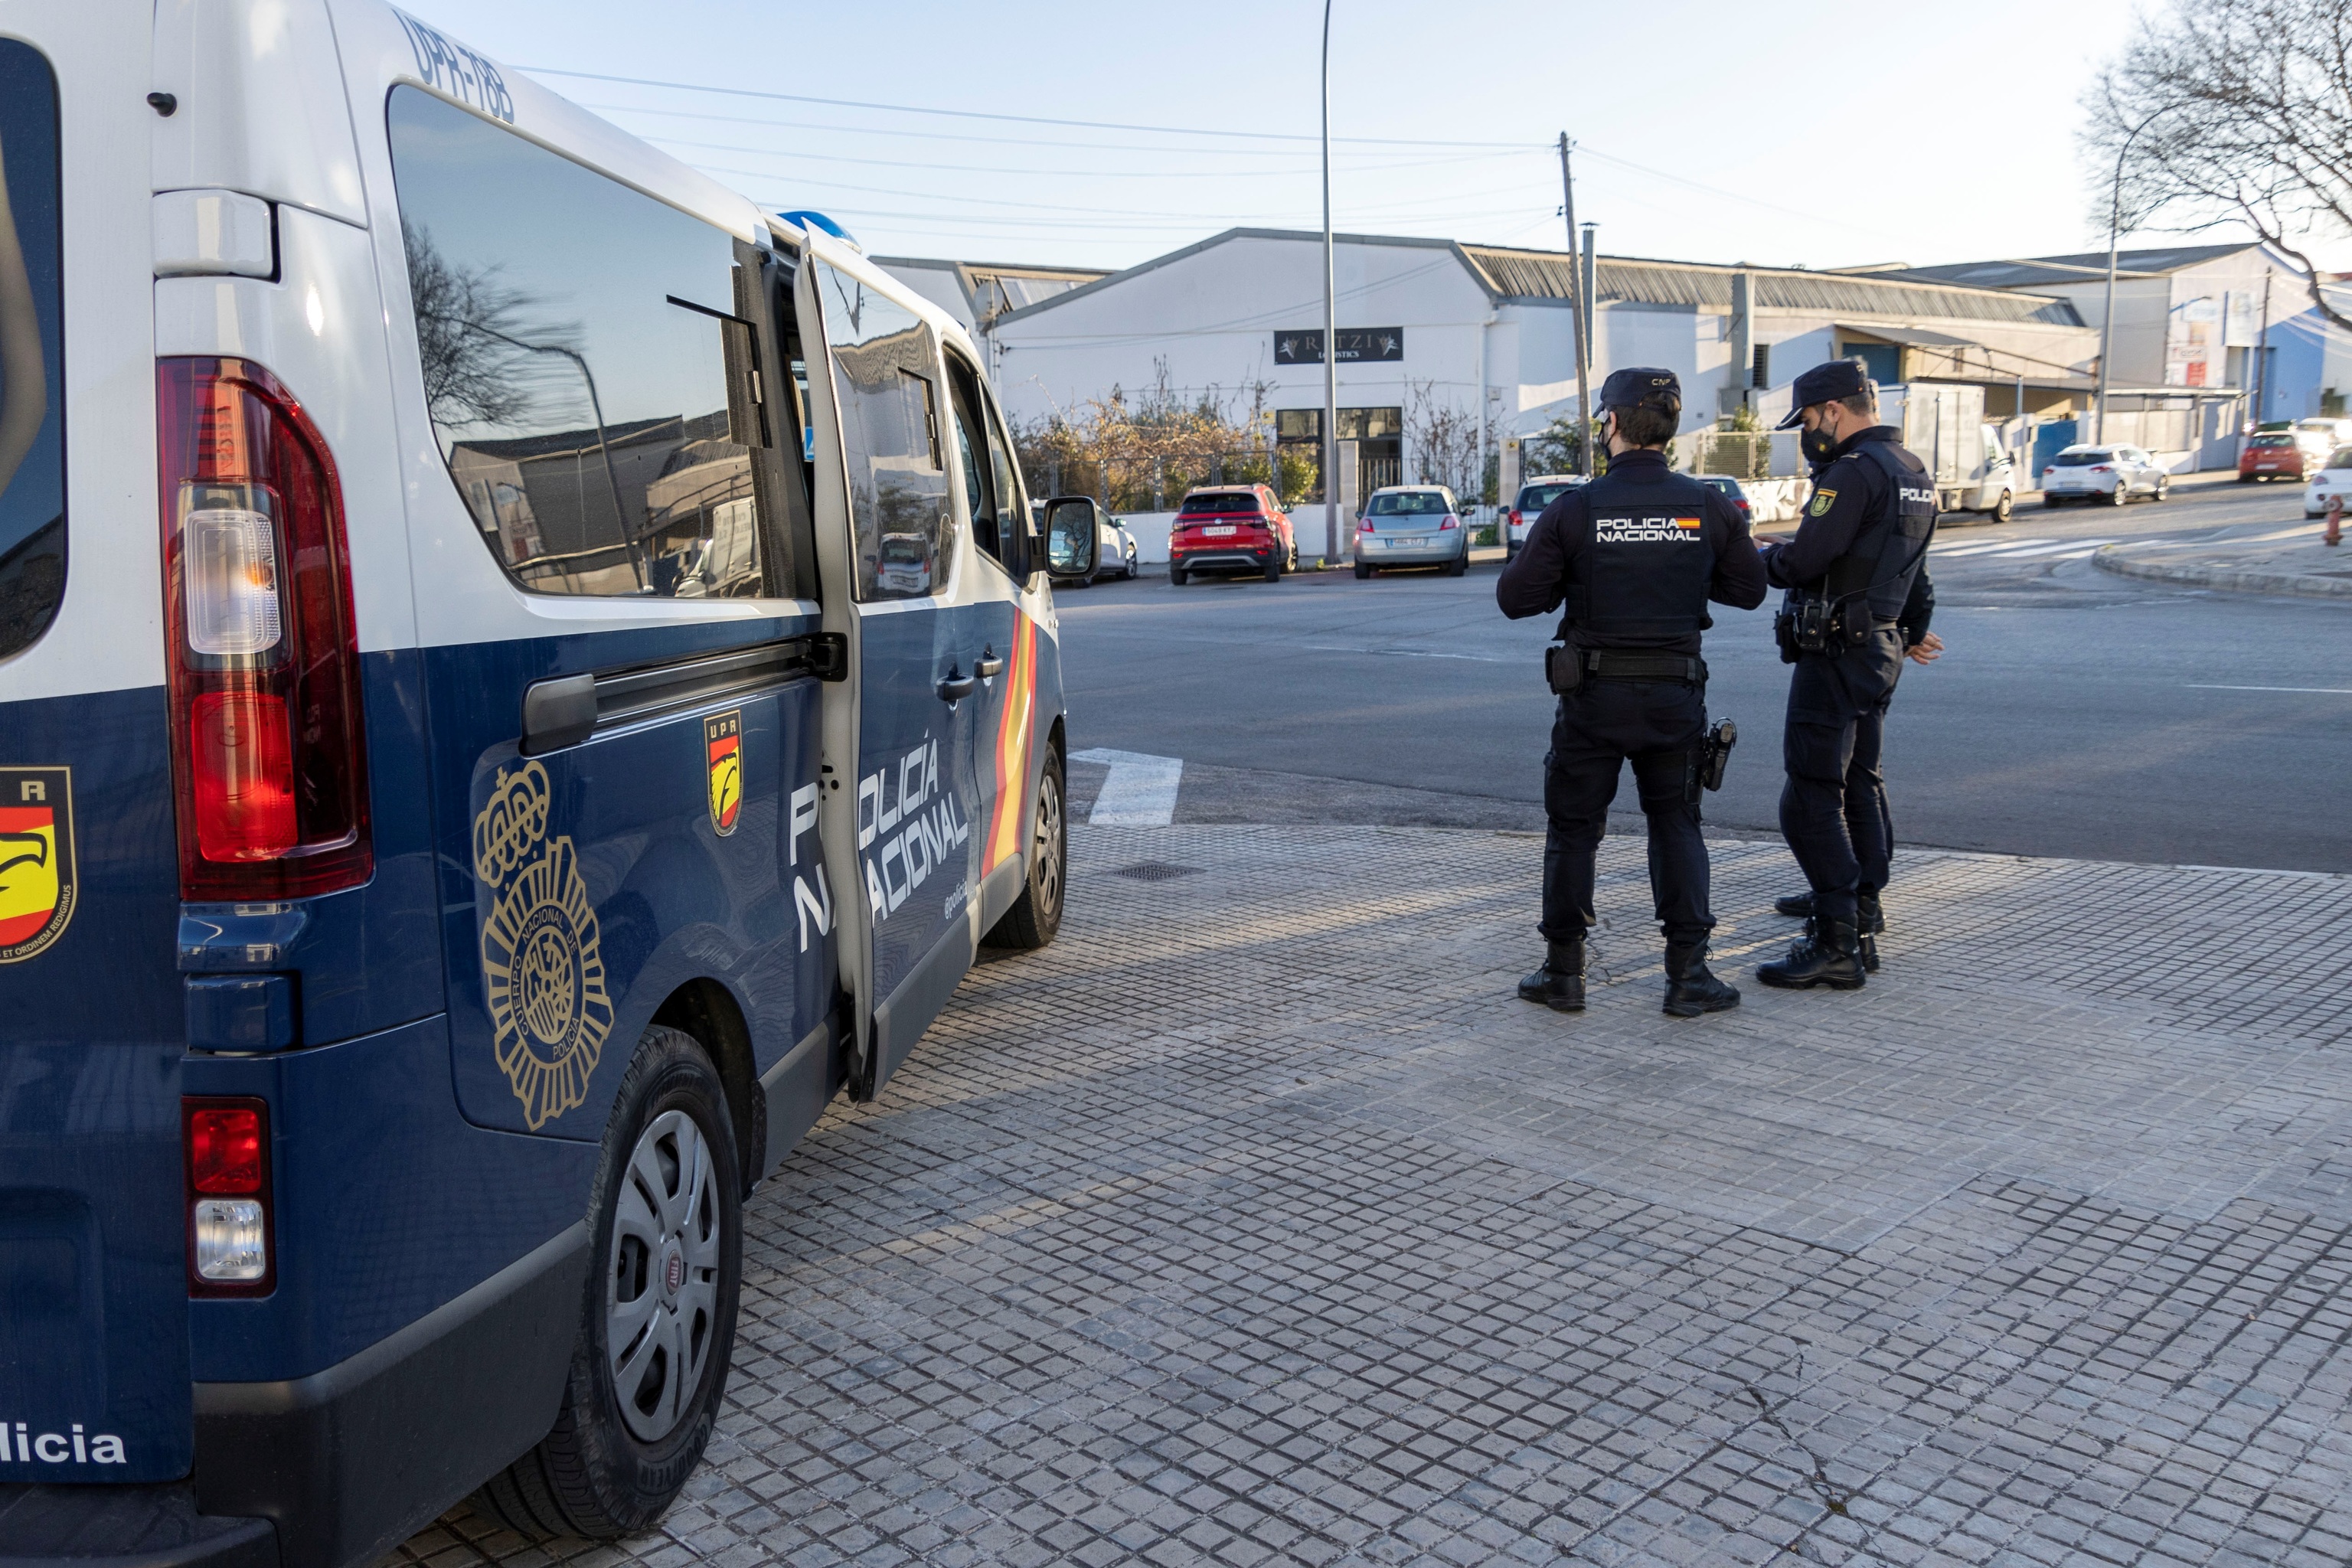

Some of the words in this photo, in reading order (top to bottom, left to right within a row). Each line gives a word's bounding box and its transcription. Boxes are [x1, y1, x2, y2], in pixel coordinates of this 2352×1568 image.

[1305, 335, 1371, 350] RTZI
[1596, 518, 1680, 531] POLICIA
[1596, 530, 1700, 543] NACIONAL
[710, 720, 737, 739] UPR
[794, 792, 969, 953] NACIONAL
[2, 949, 14, 958] ET
[15, 929, 53, 956] ORDINEM
[49, 884, 71, 932] REDIGIMUS
[521, 908, 564, 945] NACIONAL
[566, 929, 578, 956] DE
[512, 956, 530, 1036] CUERPO
[553, 1016, 580, 1060] POLICIA
[669, 1259, 679, 1286] FIAT
